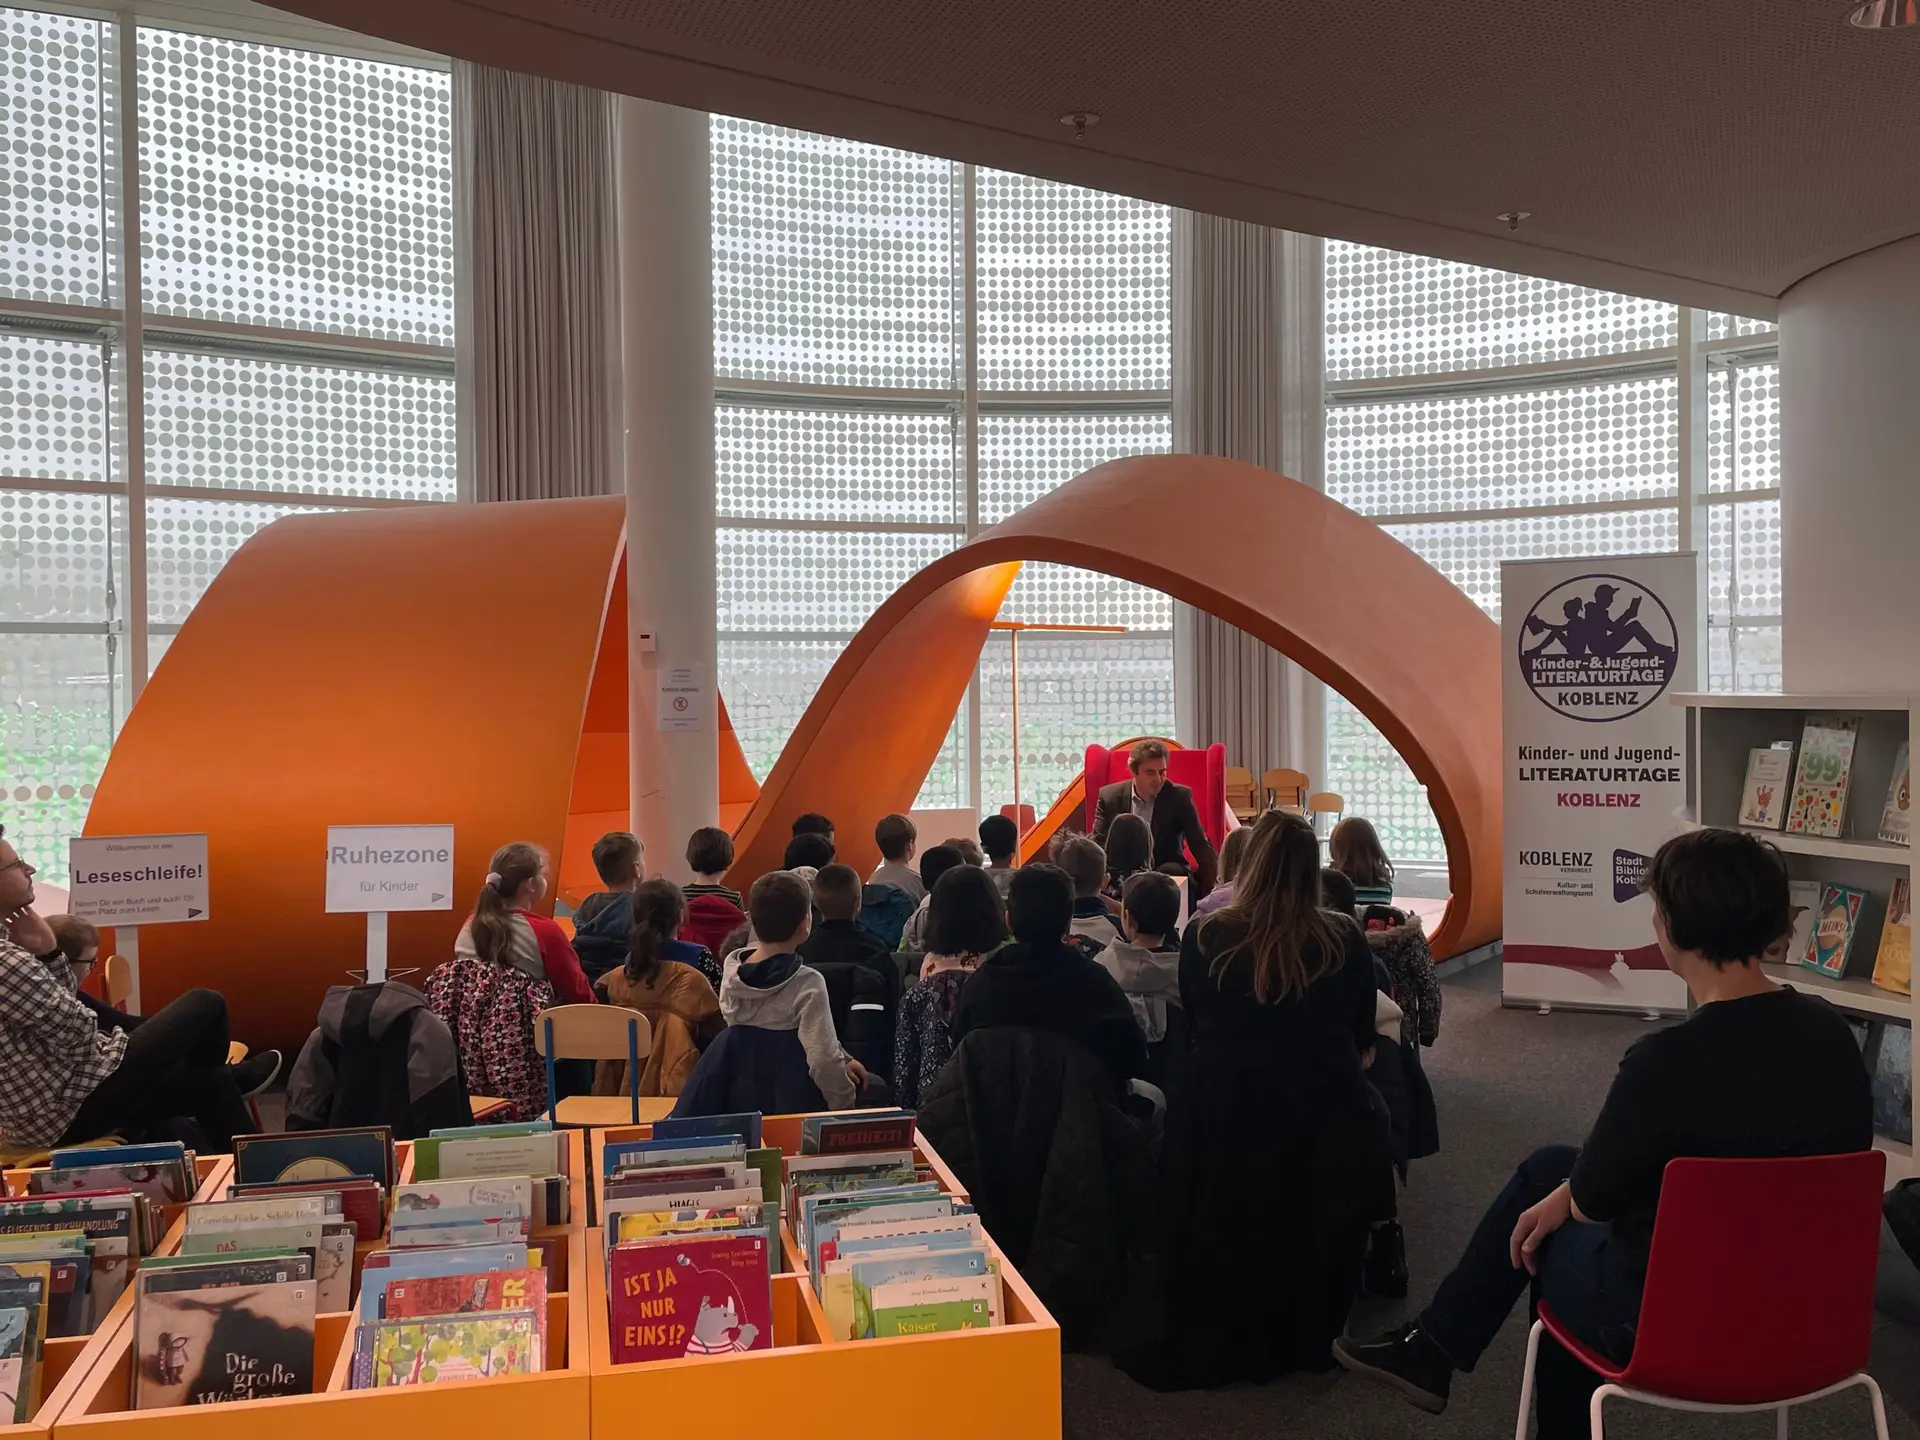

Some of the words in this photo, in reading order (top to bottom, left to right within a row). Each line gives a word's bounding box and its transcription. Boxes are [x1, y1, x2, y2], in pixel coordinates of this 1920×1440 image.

[1532, 670, 1664, 684] LITERATURTAGE
[1558, 692, 1639, 706] KOBLENZ
[1519, 746, 1574, 760] Kinder-
[1580, 746, 1608, 760] und
[1614, 746, 1680, 763] Jugend-
[1519, 768, 1680, 782] LITERATURTAGE
[1805, 752, 1841, 782] 99
[1557, 793, 1641, 808] KOBLENZ
[332, 846, 449, 865] Ruhezone
[1520, 851, 1593, 867] KOBLENZ
[1616, 857, 1643, 866] Stadt
[76, 864, 202, 884] Leseschleife!
[360, 881, 376, 892] für
[380, 880, 420, 892] Kinder
[624, 1272, 651, 1297] IST
[657, 1266, 678, 1293] JA
[640, 1298, 676, 1319] NUR
[624, 1324, 686, 1347] EINS!?
[898, 1321, 938, 1334] Kaiser
[226, 1352, 258, 1374] Die
[234, 1364, 295, 1394] große
